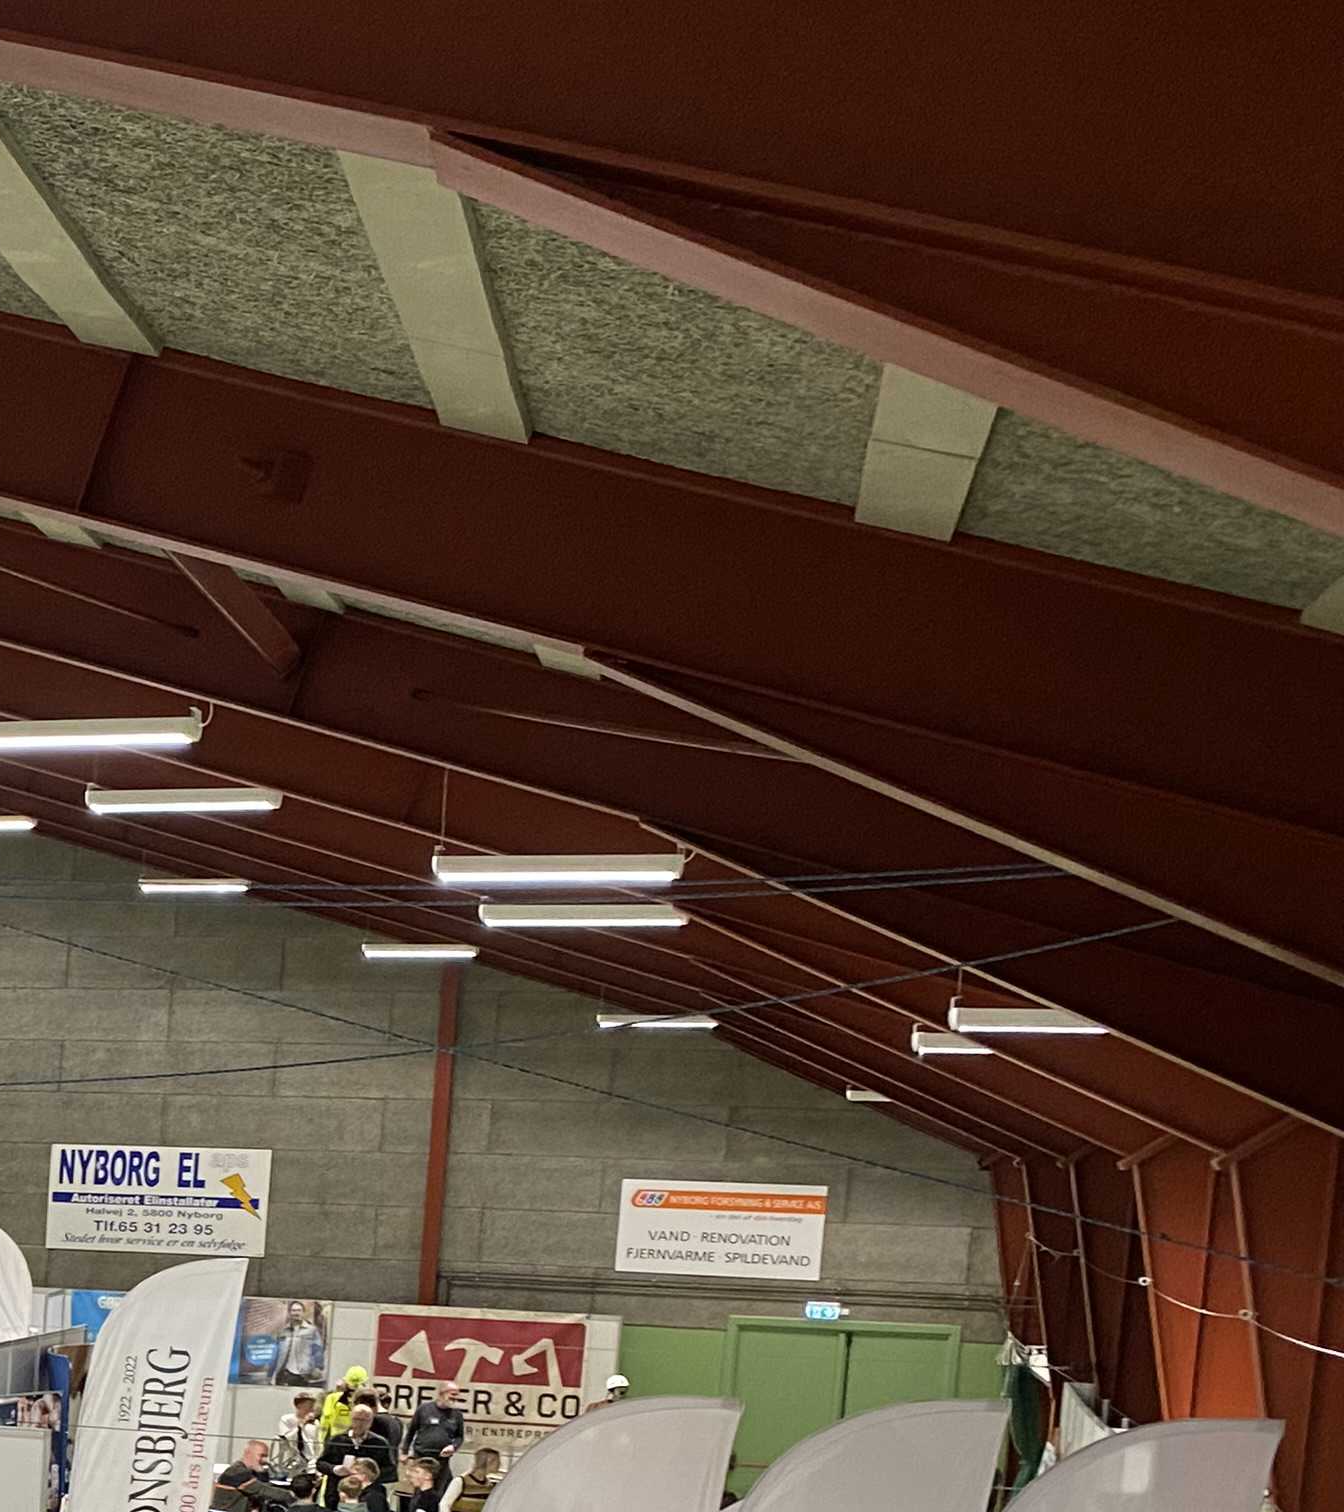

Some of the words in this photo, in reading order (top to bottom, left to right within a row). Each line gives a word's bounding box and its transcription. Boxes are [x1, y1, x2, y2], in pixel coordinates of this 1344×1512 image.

[59, 1148, 161, 1188] NYBORG
[177, 1152, 206, 1189] EL
[71, 1193, 140, 1206] Autoriseret
[142, 1209, 173, 1218] 5800
[177, 1210, 223, 1221] Nyborg
[93, 1220, 138, 1233] Tlf.65
[143, 1222, 161, 1234] 31
[168, 1223, 188, 1235] 23
[194, 1223, 214, 1235] 95
[126, 1236, 164, 1247] service
[648, 1230, 690, 1242] VAND
[700, 1231, 791, 1247] RENOVATION
[626, 1247, 715, 1263] FJERNVARME
[724, 1251, 812, 1267] SPILDEVAND
[123, 1355, 138, 1385] 2022
[118, 1395, 132, 1423] 1922
[504, 1390, 525, 1417] &
[537, 1393, 580, 1419] CO
[188, 1376, 215, 1461] jubilæum
